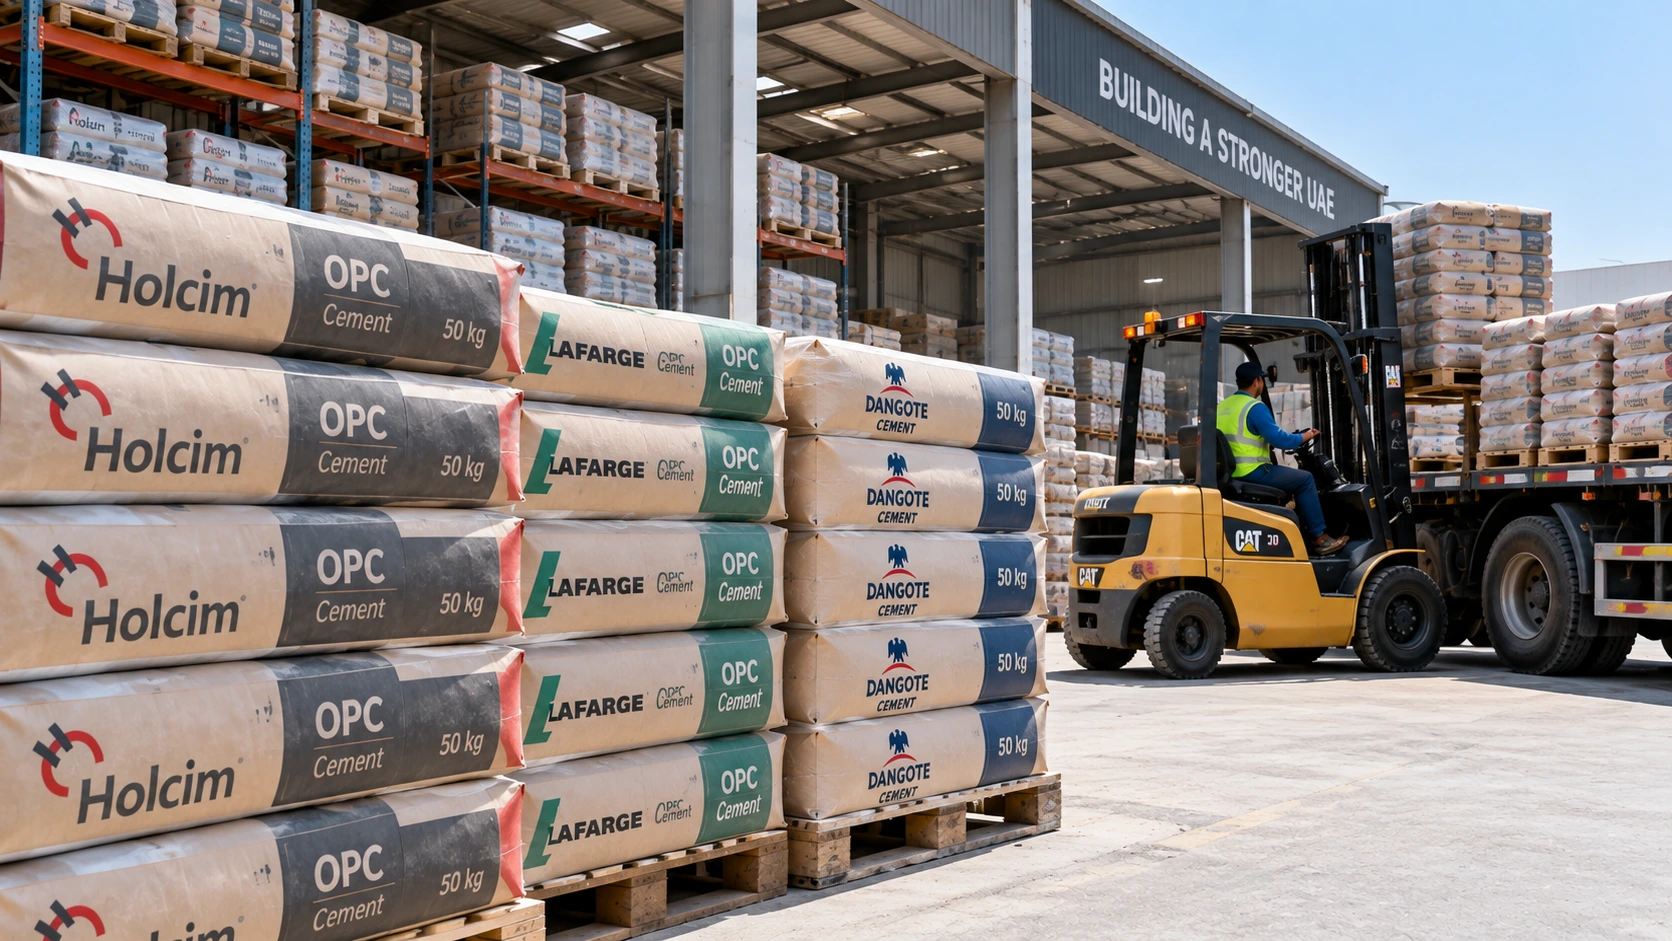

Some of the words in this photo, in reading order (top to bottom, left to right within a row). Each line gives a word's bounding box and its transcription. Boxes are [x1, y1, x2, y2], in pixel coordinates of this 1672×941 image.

[1099, 57, 1195, 145] BUILDING
[1199, 118, 1213, 156] A
[1217, 127, 1303, 204] STRONGER
[1306, 176, 1335, 220] UAE
[95, 256, 251, 318] Holcim
[324, 254, 390, 298] OPC
[323, 303, 392, 334] Cement
[443, 318, 463, 341] 50
[465, 322, 486, 348] kg
[550, 338, 644, 368] LAFARGE
[722, 344, 759, 370] OPC
[720, 372, 763, 395] Cement
[865, 395, 928, 419] DANGOTE
[996, 401, 1011, 420] 50
[1014, 403, 1027, 427] kg
[319, 401, 387, 440] OPC
[876, 419, 916, 434] CEMENT
[84, 426, 242, 475] Holcim
[318, 451, 387, 475] Cement
[722, 445, 759, 470] OPC
[440, 455, 461, 477] 50
[464, 456, 484, 482] kg
[549, 456, 644, 478] LAFARGE
[719, 475, 763, 497] Cement
[867, 488, 929, 508] DANGOTE
[997, 483, 1011, 501] 50
[1014, 484, 1027, 506] kg
[877, 511, 918, 524] CEMENT
[1235, 529, 1262, 552] CAT
[316, 549, 385, 585] OPC
[722, 552, 759, 575] OPC
[549, 577, 644, 597] LAFARGE
[867, 581, 930, 600] DANGOTE
[997, 567, 1012, 586] 50
[1014, 568, 1027, 590] kg
[1079, 568, 1098, 587] CAT
[718, 581, 763, 602] Cement
[81, 590, 239, 645] Holcim
[316, 599, 385, 622] Cement
[440, 593, 460, 614] 50
[464, 592, 484, 618] kg
[878, 604, 918, 617] CEMENT
[721, 660, 759, 686] OPC
[998, 654, 1012, 672] 50
[1014, 652, 1027, 674] kg
[866, 674, 929, 698] DANGOTE
[548, 694, 644, 722] LAFARGE
[717, 688, 763, 713] Cement
[877, 697, 917, 712] CEMENT
[315, 696, 384, 739] OPC
[439, 734, 461, 756] 50
[463, 730, 484, 754] kg
[998, 737, 1013, 757] 50
[1015, 735, 1028, 757] kg
[313, 747, 383, 779] Cement
[867, 762, 931, 790] DANGOTE
[77, 759, 235, 824] Holcim
[720, 765, 758, 795] OPC
[716, 794, 762, 821] Cement
[879, 786, 918, 804] CEMENT
[547, 811, 643, 845] LAFARGE
[314, 844, 384, 892] OPC
[439, 873, 461, 895] 50
[464, 868, 484, 892] kg
[313, 893, 383, 931] Cement
